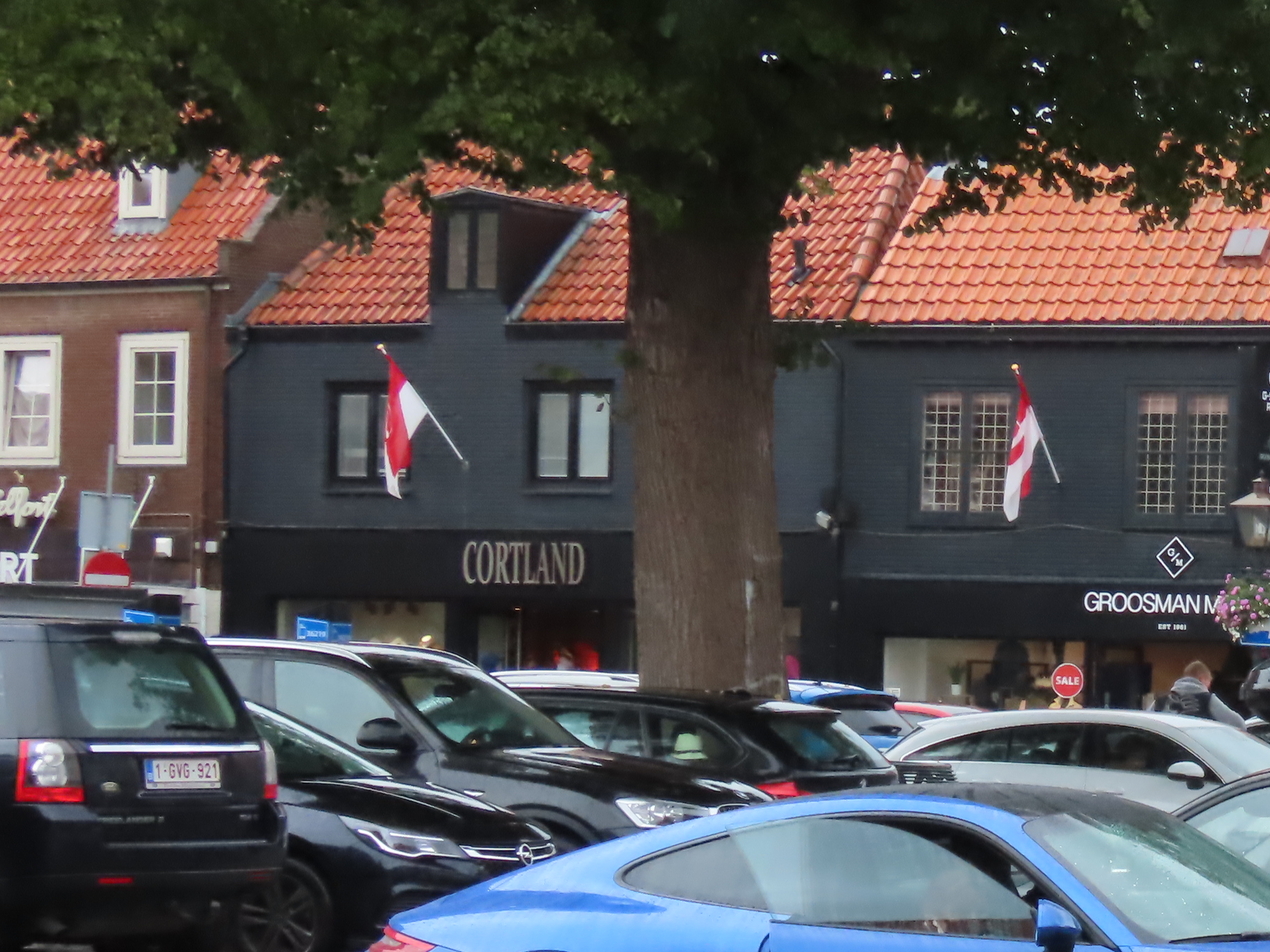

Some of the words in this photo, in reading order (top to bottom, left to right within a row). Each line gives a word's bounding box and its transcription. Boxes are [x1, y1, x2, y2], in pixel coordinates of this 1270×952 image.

[0, 551, 39, 584] RT
[463, 541, 585, 585] CORTLAND
[1084, 591, 1200, 615] GROOSMAN
[1204, 595, 1222, 615] M
[1158, 623, 1172, 631] EST
[1055, 675, 1080, 686] SALE
[155, 762, 217, 779] 1-GVG-921
